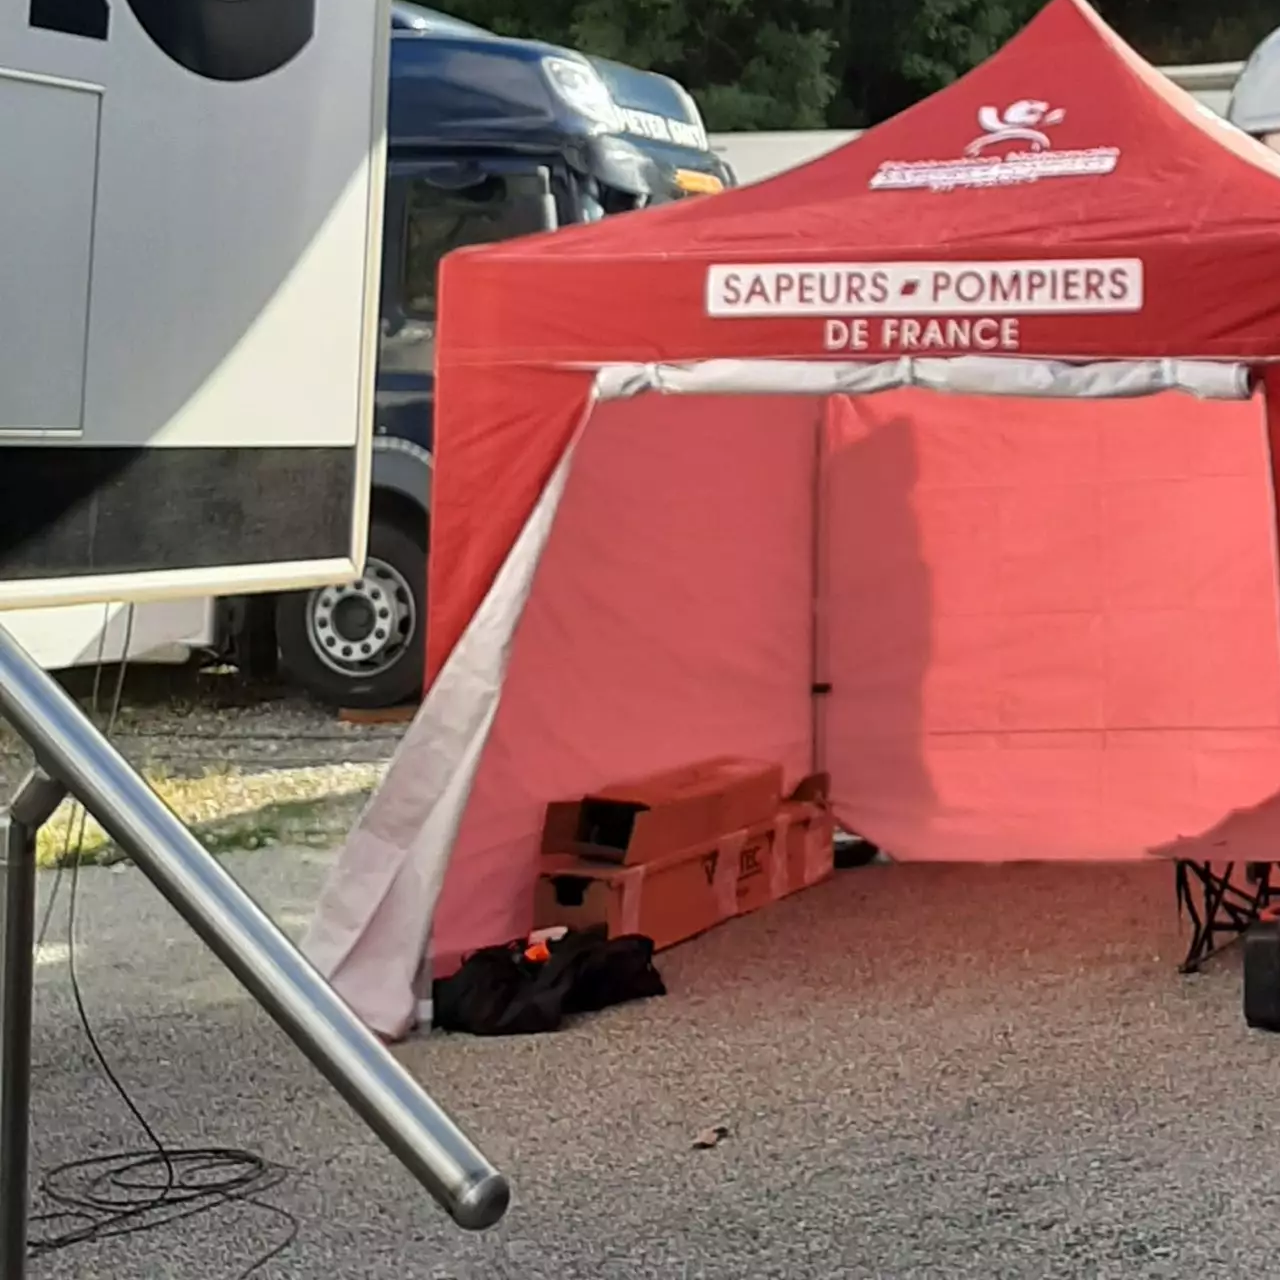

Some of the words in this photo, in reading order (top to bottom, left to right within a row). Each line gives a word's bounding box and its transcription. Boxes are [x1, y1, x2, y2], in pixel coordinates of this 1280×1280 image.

[722, 270, 890, 306] SAPEURS
[931, 267, 1130, 305] POMPIERS
[825, 319, 869, 351] DE
[881, 317, 1020, 350] FRANCE
